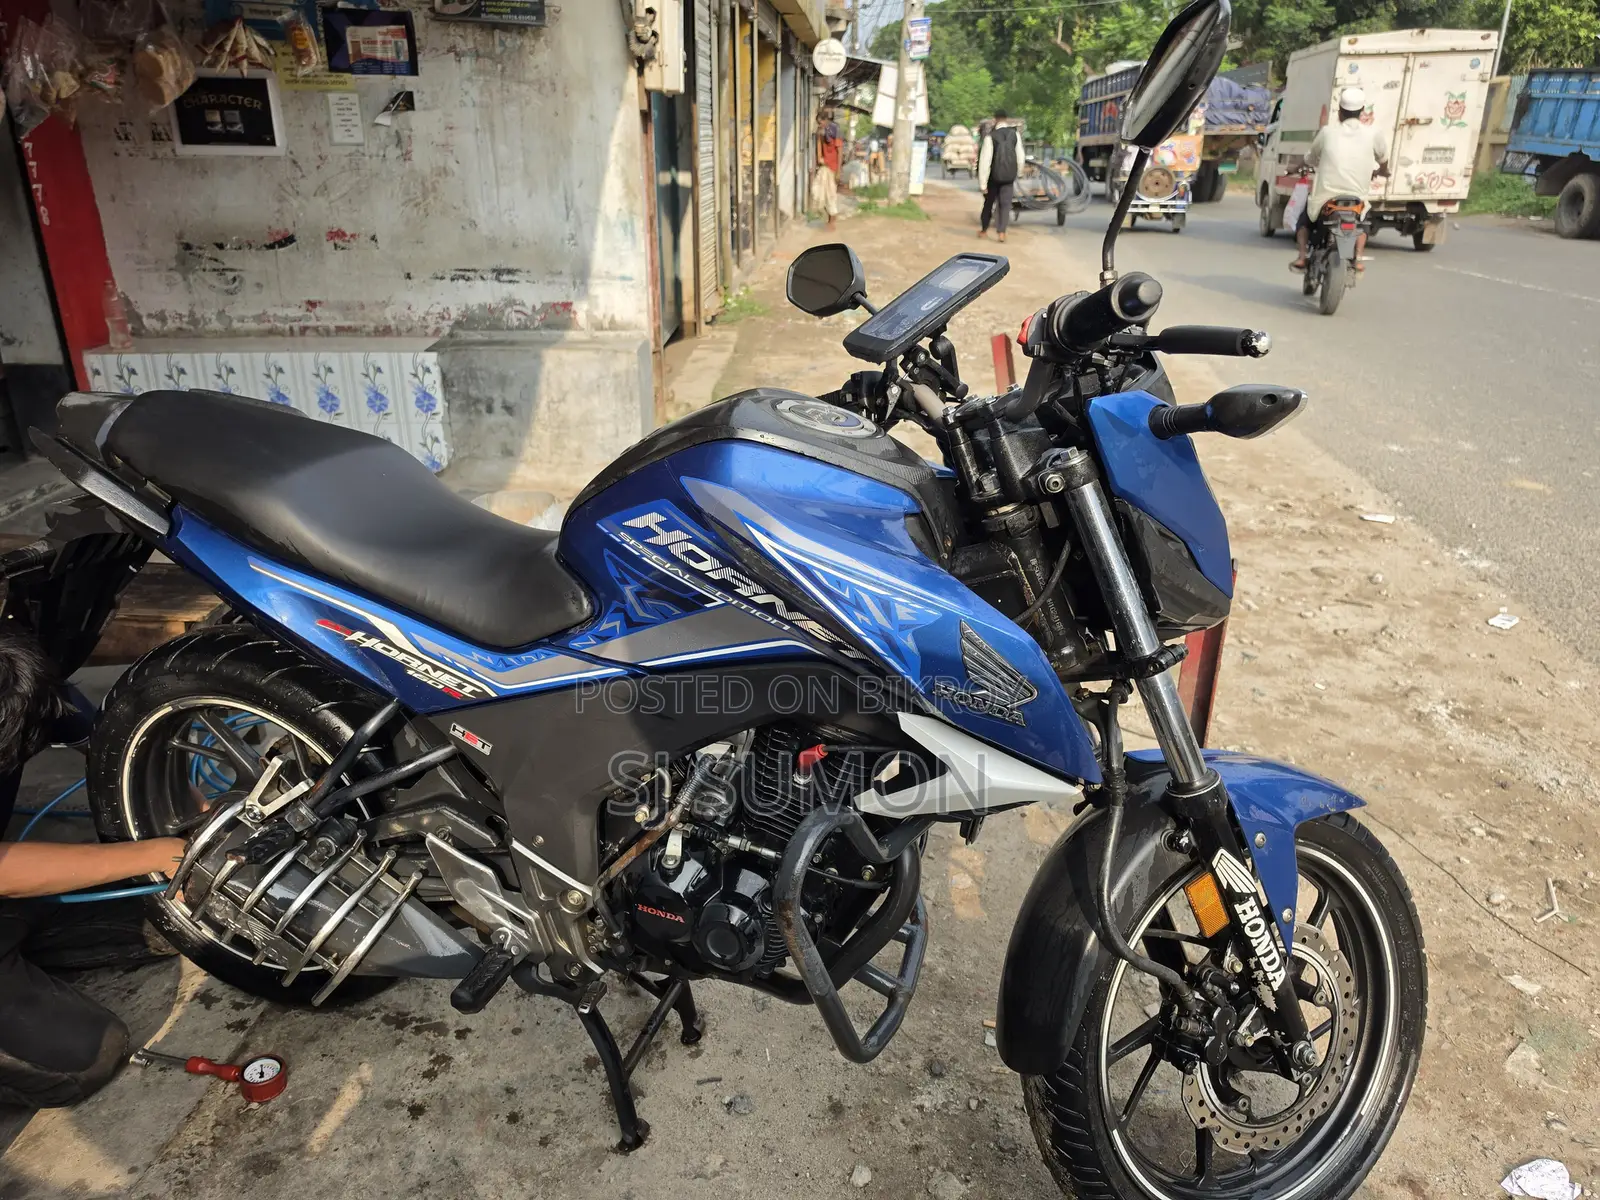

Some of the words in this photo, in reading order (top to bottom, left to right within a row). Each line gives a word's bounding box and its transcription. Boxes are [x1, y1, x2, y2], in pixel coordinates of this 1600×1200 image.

[183, 93, 263, 111] CHARACTER
[617, 531, 699, 584] SPECIAL
[701, 580, 791, 632] EDITION
[344, 630, 483, 695] HORNET
[406, 669, 464, 700] 160R
[932, 679, 1027, 728] HONDA
[637, 903, 686, 924] HONDA
[1234, 896, 1287, 992] HONDA
